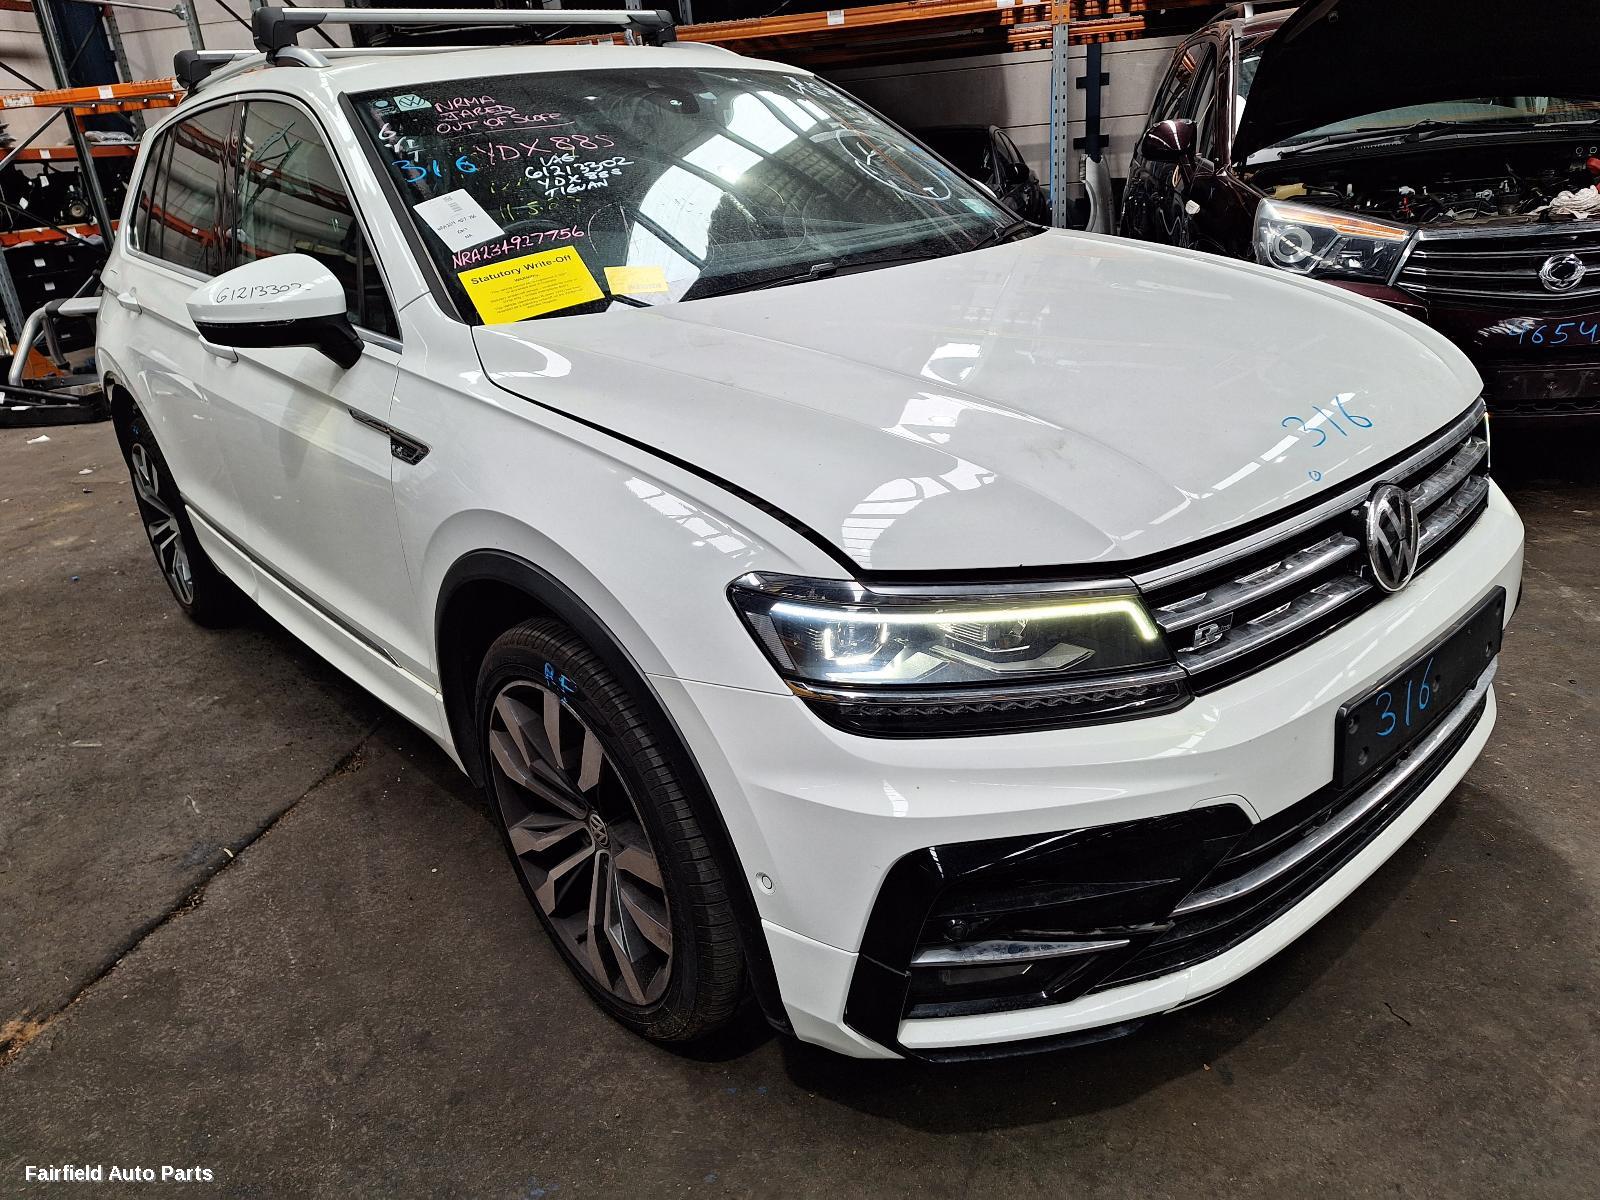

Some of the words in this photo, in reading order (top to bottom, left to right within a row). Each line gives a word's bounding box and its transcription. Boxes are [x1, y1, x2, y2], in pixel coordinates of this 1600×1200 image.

[434, 95, 495, 112] NRMA
[437, 120, 478, 133] OUT
[484, 116, 507, 126] OF
[392, 155, 478, 182] 316
[545, 179, 608, 197] TIGUAN
[471, 268, 521, 285] Statutory
[523, 254, 572, 271] Write-Off
[1281, 396, 1373, 447] 316
[1375, 657, 1434, 737] 316
